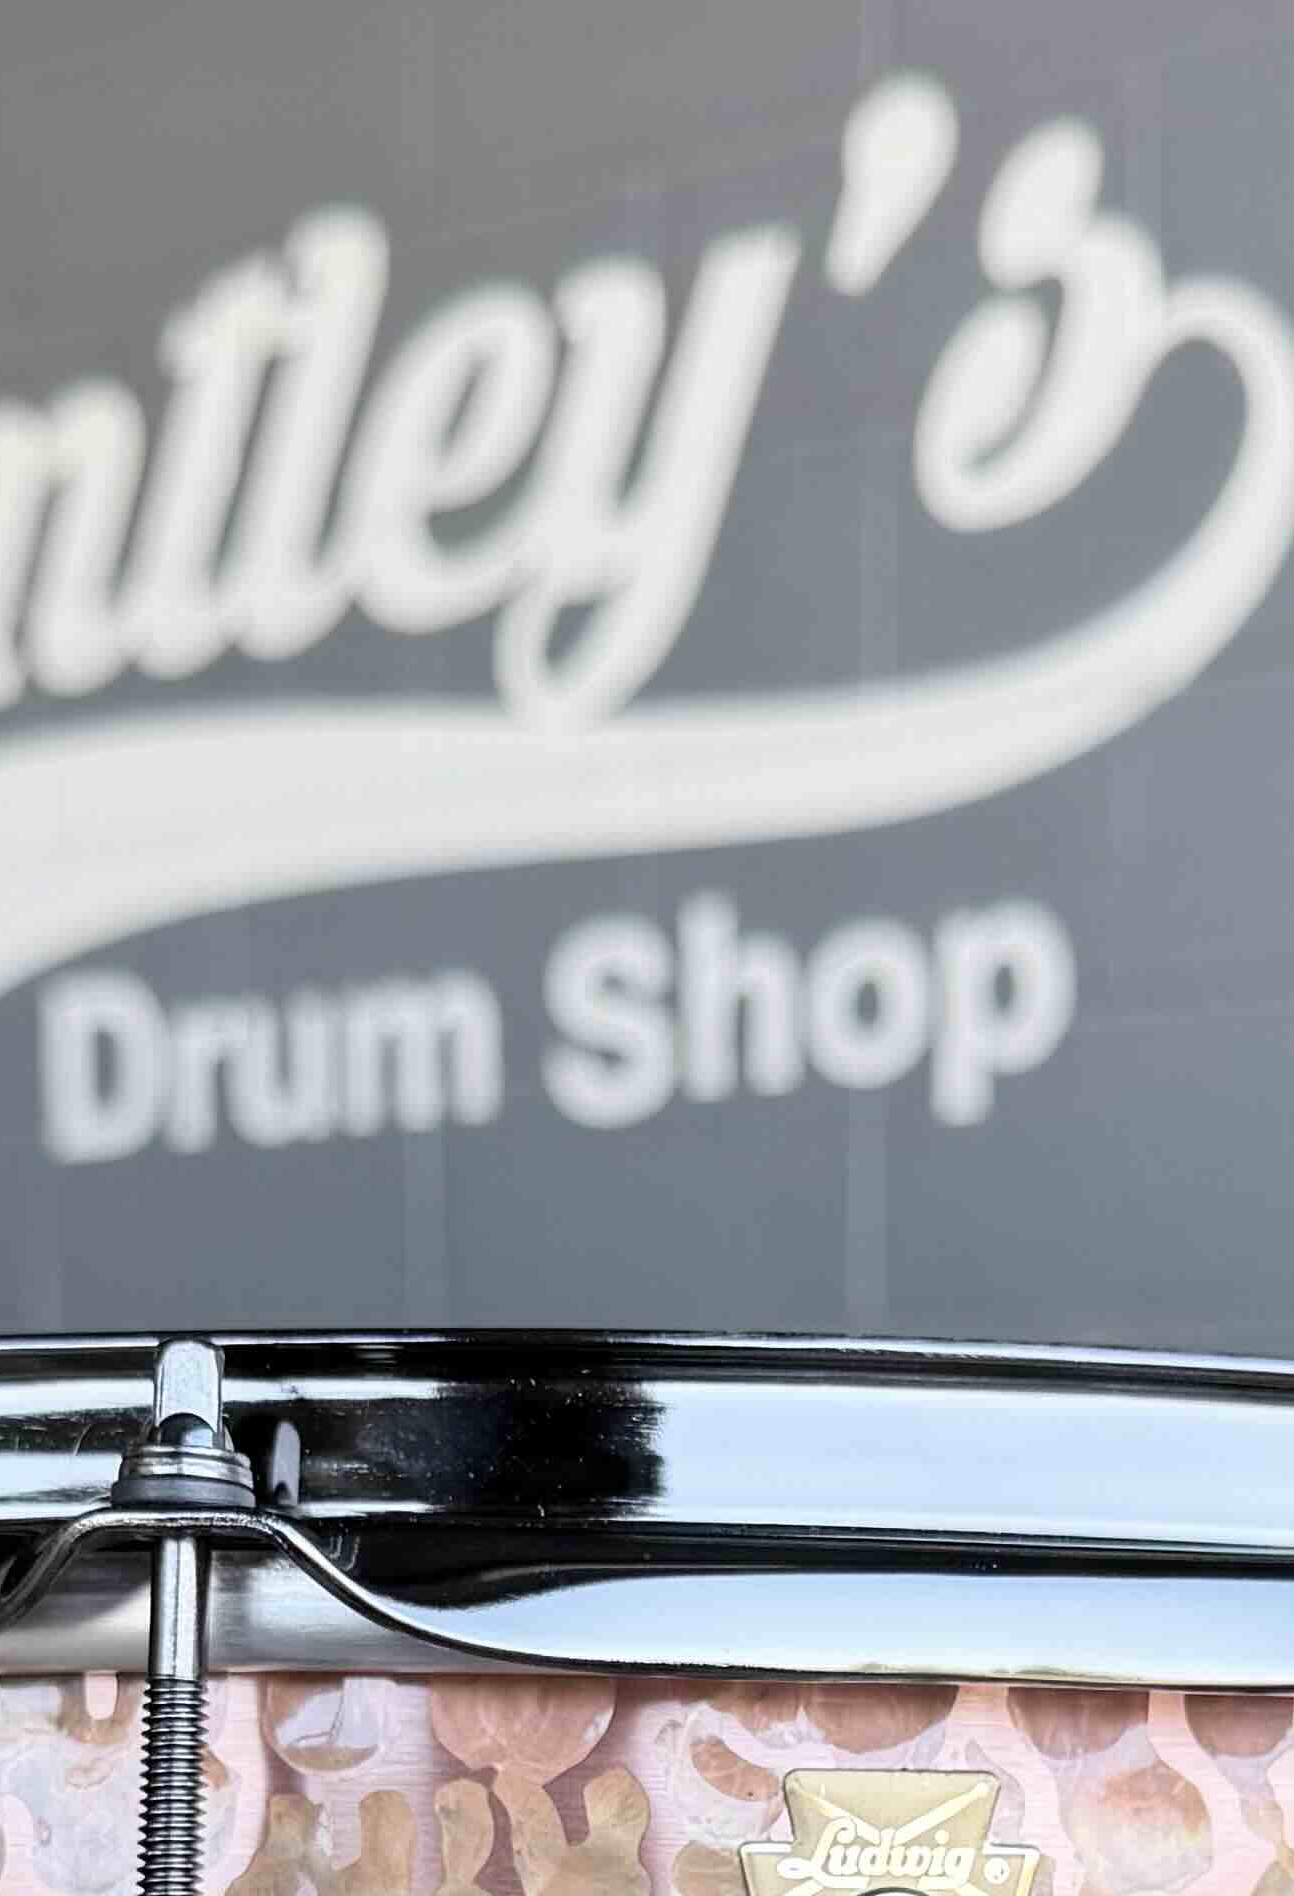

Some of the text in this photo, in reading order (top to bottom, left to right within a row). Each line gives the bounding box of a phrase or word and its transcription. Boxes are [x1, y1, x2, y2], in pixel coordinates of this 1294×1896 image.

[41, 888, 1077, 1164] Drum Shop
[777, 1817, 975, 1888] Ludwig
